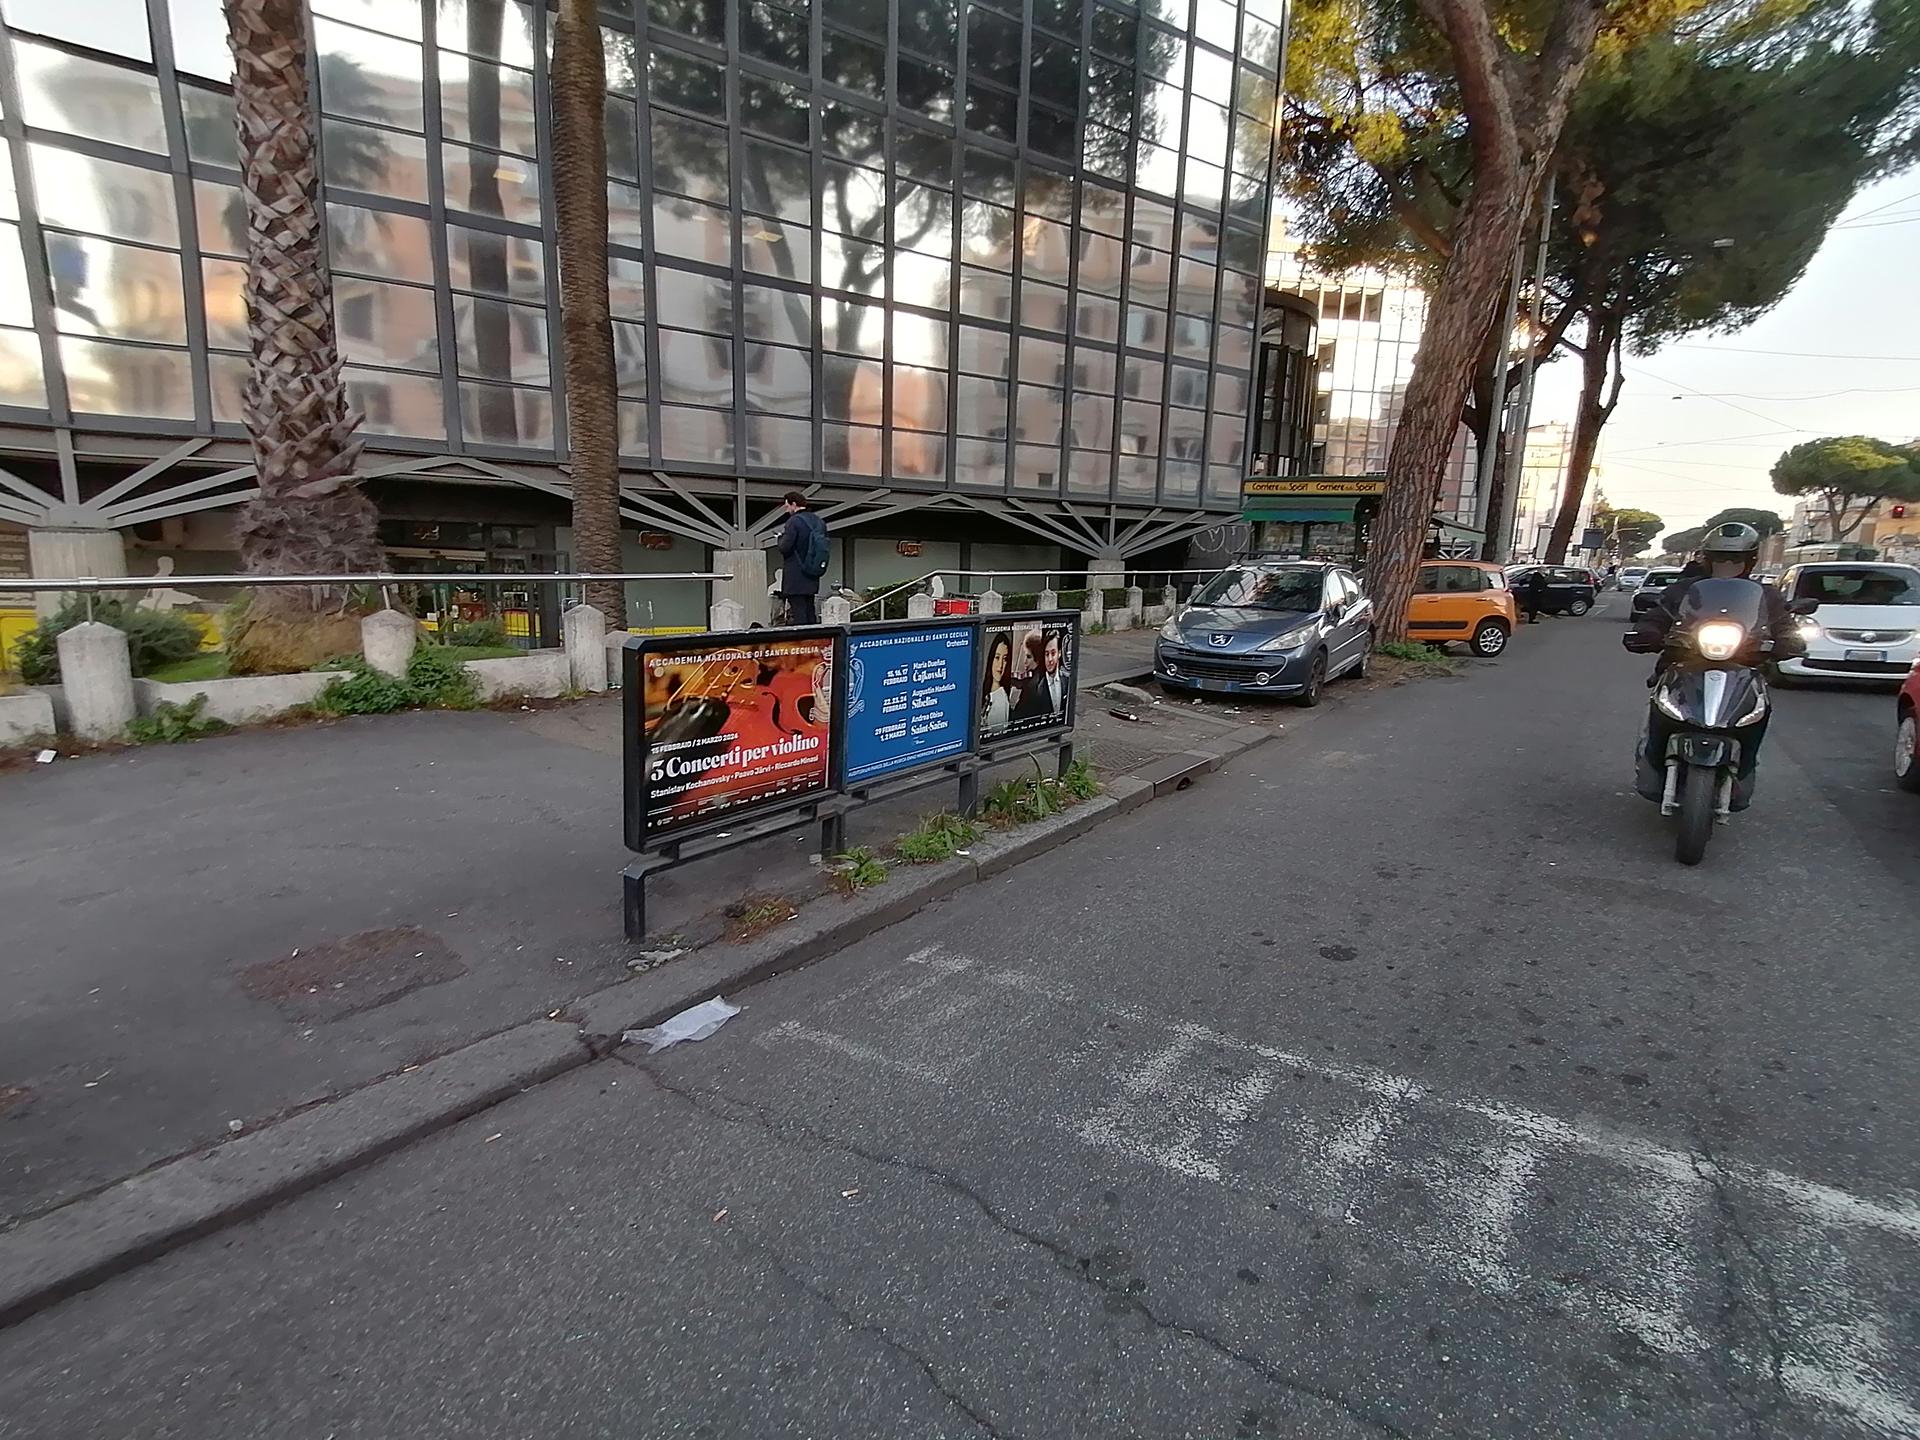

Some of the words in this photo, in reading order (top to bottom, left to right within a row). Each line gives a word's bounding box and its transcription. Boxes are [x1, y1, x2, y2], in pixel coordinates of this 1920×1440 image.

[859, 638, 893, 648] ACCADEMIA
[894, 636, 925, 645] NAZIONALE
[932, 633, 948, 641] SANTA
[949, 631, 969, 639] CECILIA
[946, 640, 969, 648] Orchestra
[649, 656, 703, 667] ACCADEMIA
[704, 651, 752, 663] NAZIONALE
[753, 650, 763, 658] DI
[764, 648, 789, 657] SANTA
[790, 646, 819, 655] CECILIA
[913, 661, 927, 670] Maria
[883, 676, 908, 686] FEBBRAIO
[882, 703, 908, 713] FEBBRAIO
[912, 696, 938, 709] Sibelius
[911, 714, 930, 723] Andrea
[882, 722, 907, 733] FEBBRAIO
[910, 720, 949, 735] Saint-Saëns
[888, 730, 906, 739] MARZO
[660, 741, 692, 753] FEBBRAIO
[701, 736, 722, 746] MARZO
[722, 733, 739, 742] 2024
[666, 747, 740, 778] Concerti
[742, 745, 770, 768] per
[771, 734, 819, 757] violino
[650, 784, 686, 799] Stanislav
[685, 774, 731, 791] Kochanovsky
[734, 768, 754, 779] Paavo
[775, 759, 801, 770] Riccardo
[800, 755, 819, 765] Minasi
